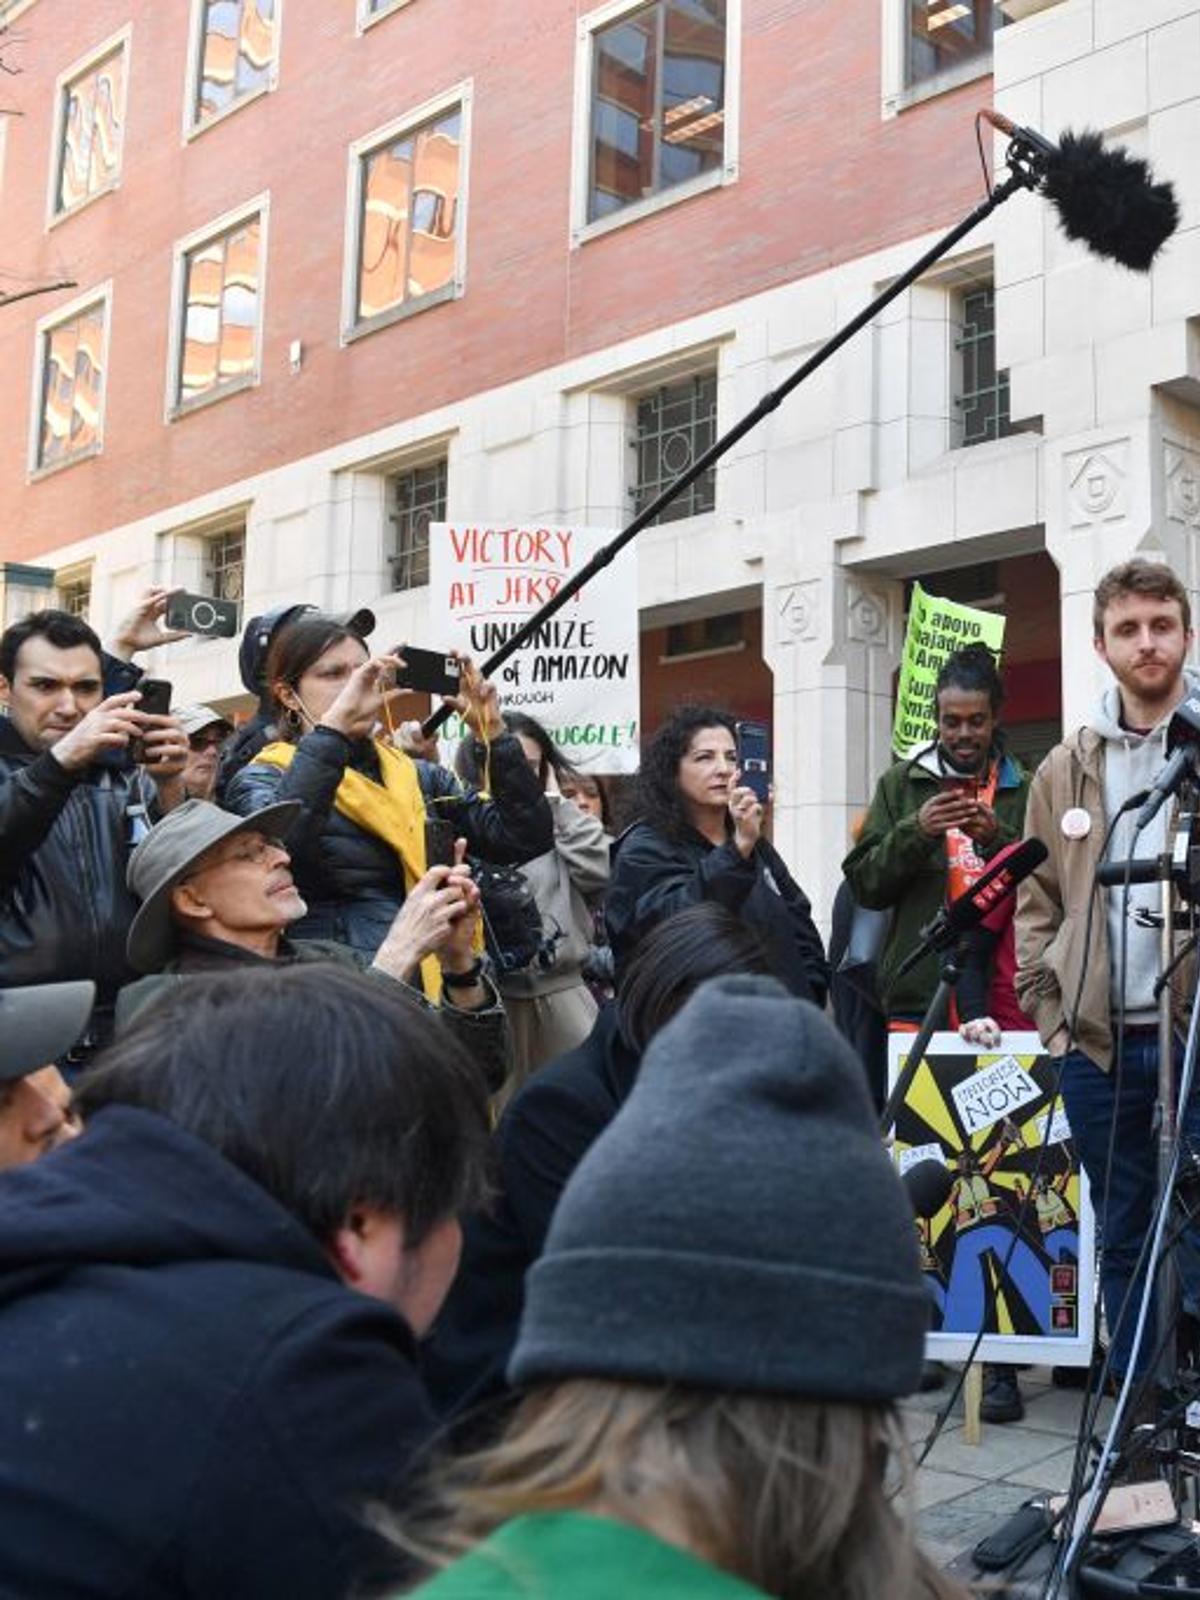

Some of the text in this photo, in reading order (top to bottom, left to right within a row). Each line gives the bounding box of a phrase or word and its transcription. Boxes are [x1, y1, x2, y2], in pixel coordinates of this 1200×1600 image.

[450, 528, 573, 568] VICTORY
[450, 580, 479, 610] AT
[930, 612, 982, 638] apoyo
[503, 654, 629, 686] of AMAZON
[965, 1074, 1033, 1127] NOW
